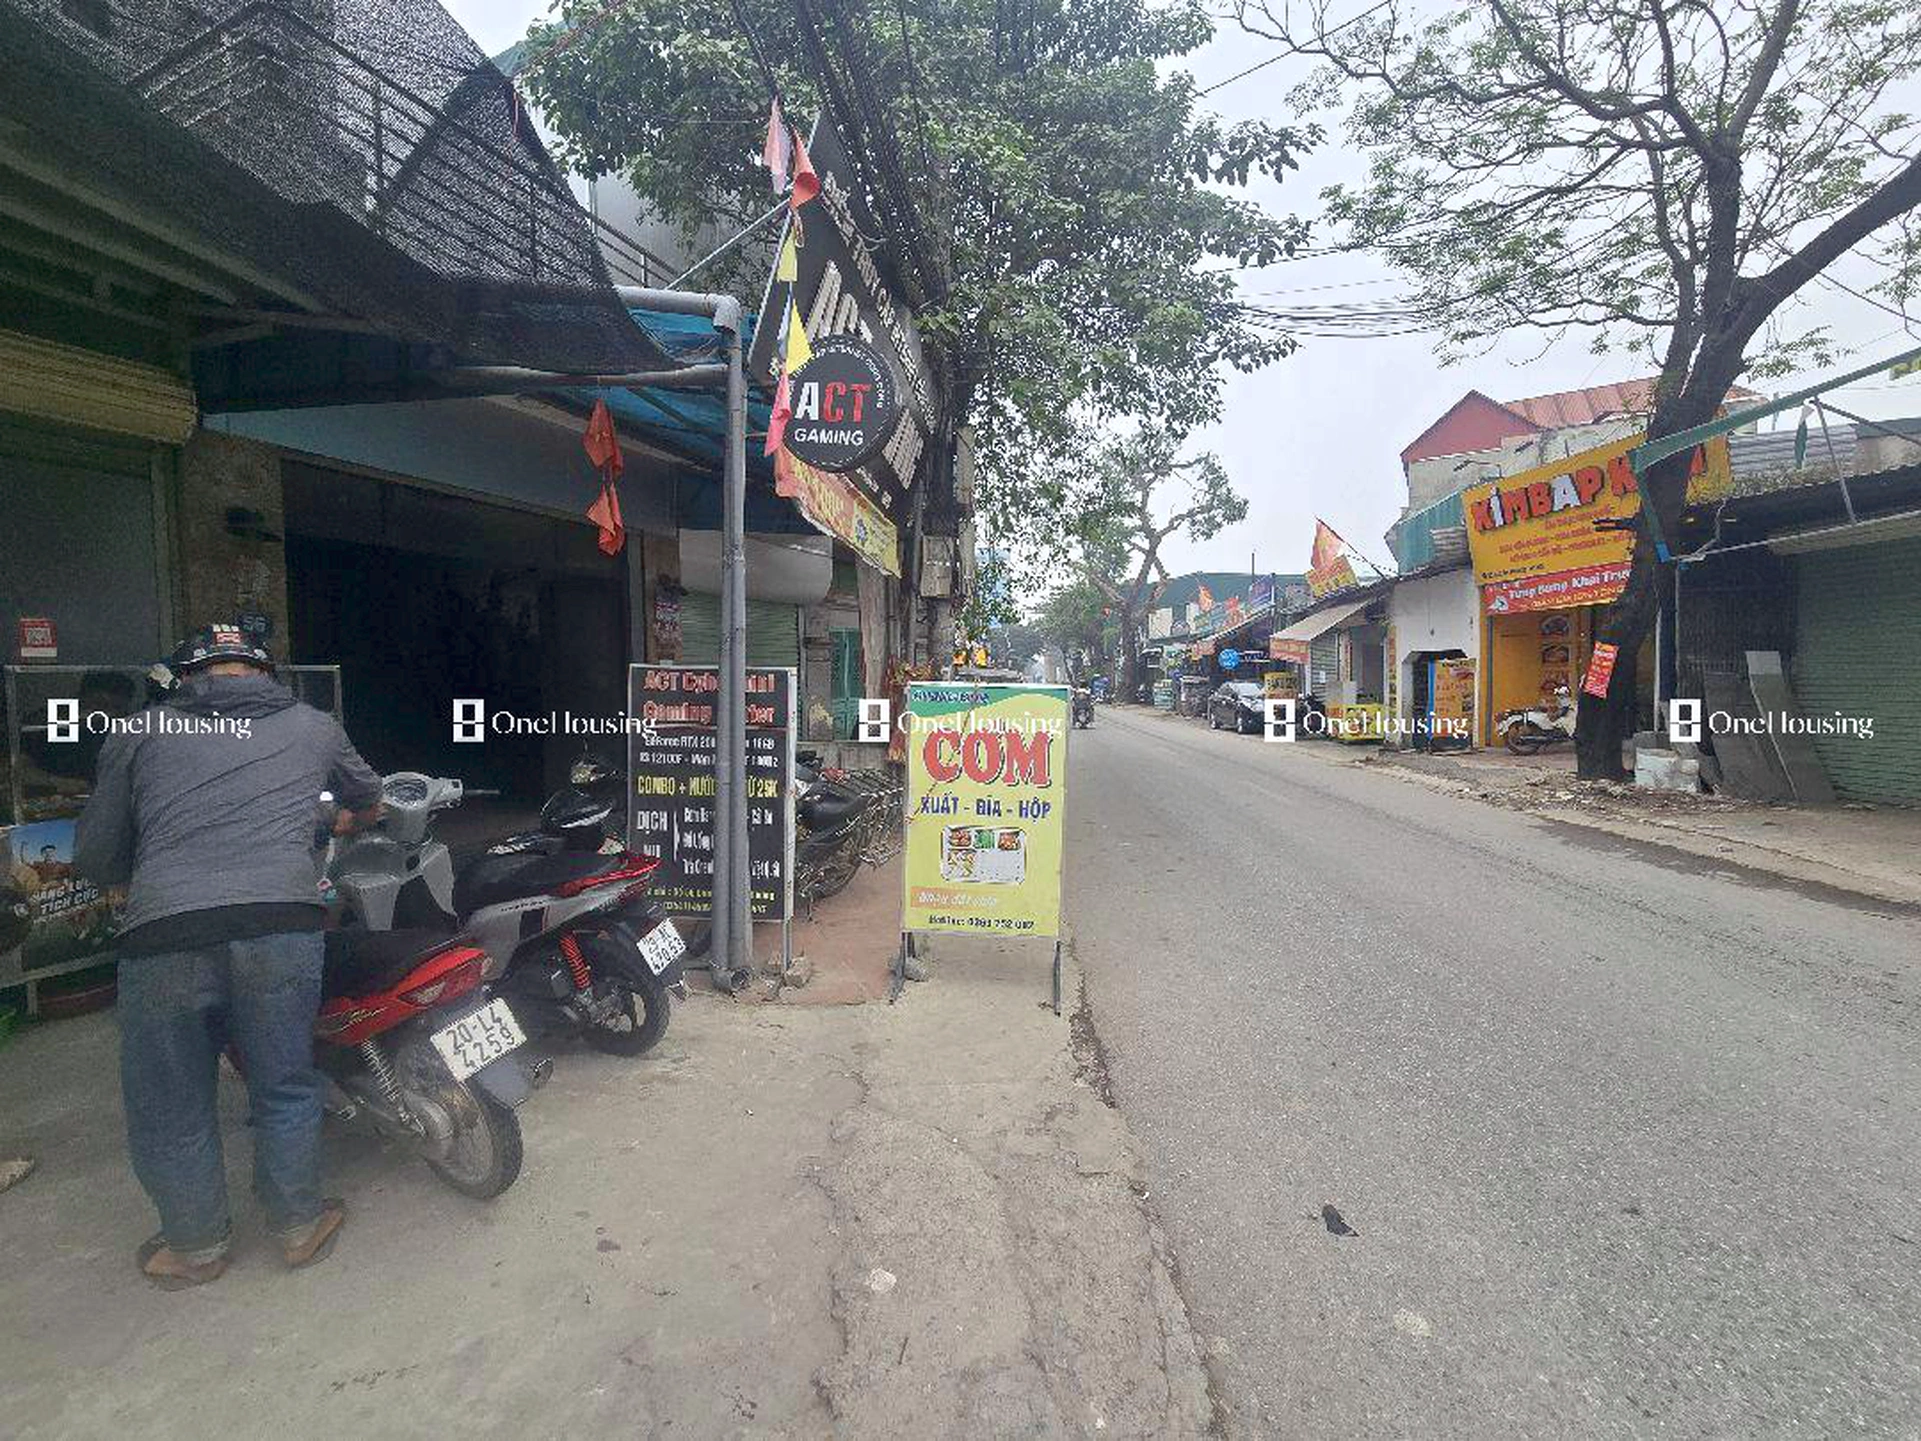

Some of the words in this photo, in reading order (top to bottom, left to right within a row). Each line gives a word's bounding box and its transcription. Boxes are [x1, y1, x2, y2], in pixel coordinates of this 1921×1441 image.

[794, 381, 872, 423] ACT
[794, 427, 864, 446] GAMING
[643, 670, 680, 693] ACT
[637, 776, 676, 797] COMBO
[920, 791, 960, 815] XUẤT
[636, 809, 669, 836] DỊCH
